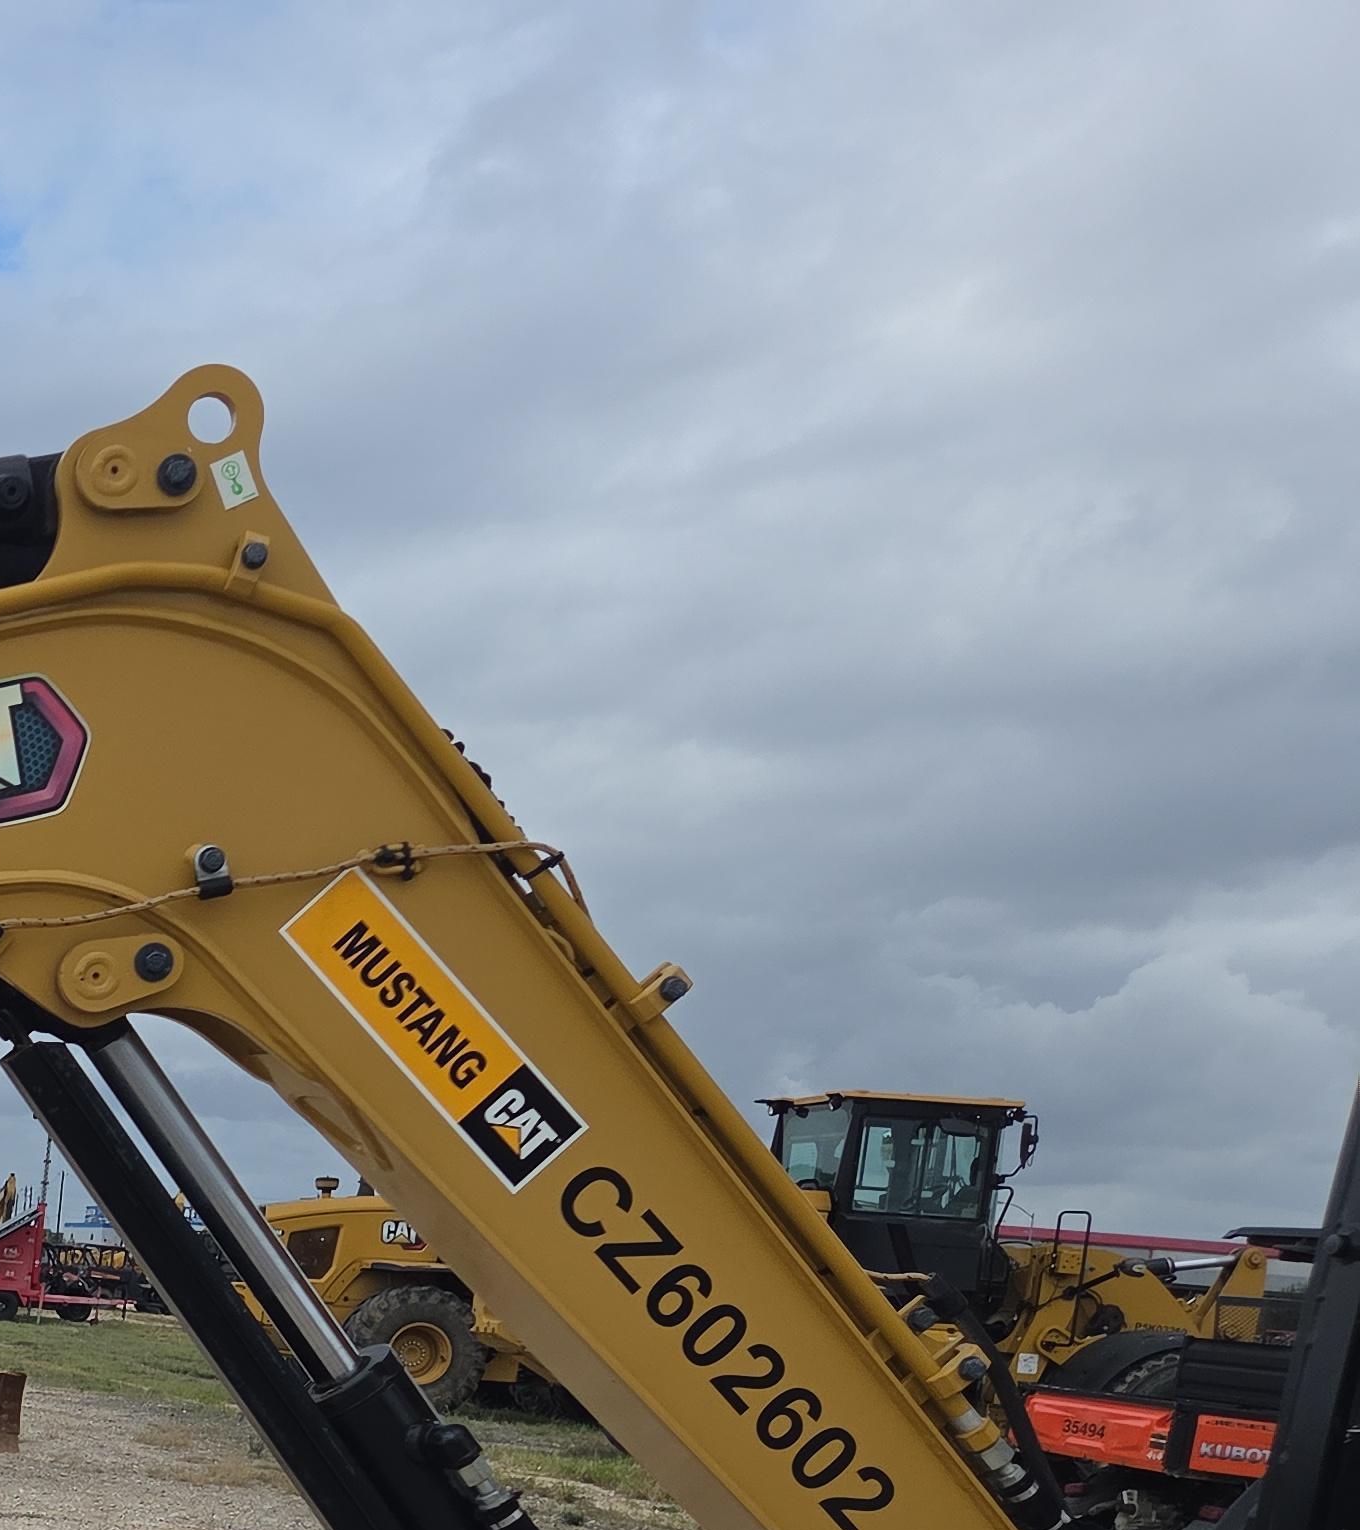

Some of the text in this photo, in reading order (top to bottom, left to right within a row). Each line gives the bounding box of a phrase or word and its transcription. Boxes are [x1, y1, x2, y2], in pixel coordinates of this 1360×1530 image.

[332, 920, 558, 1160] MUSTANG CAT
[1062, 1419, 1106, 1439] 35494
